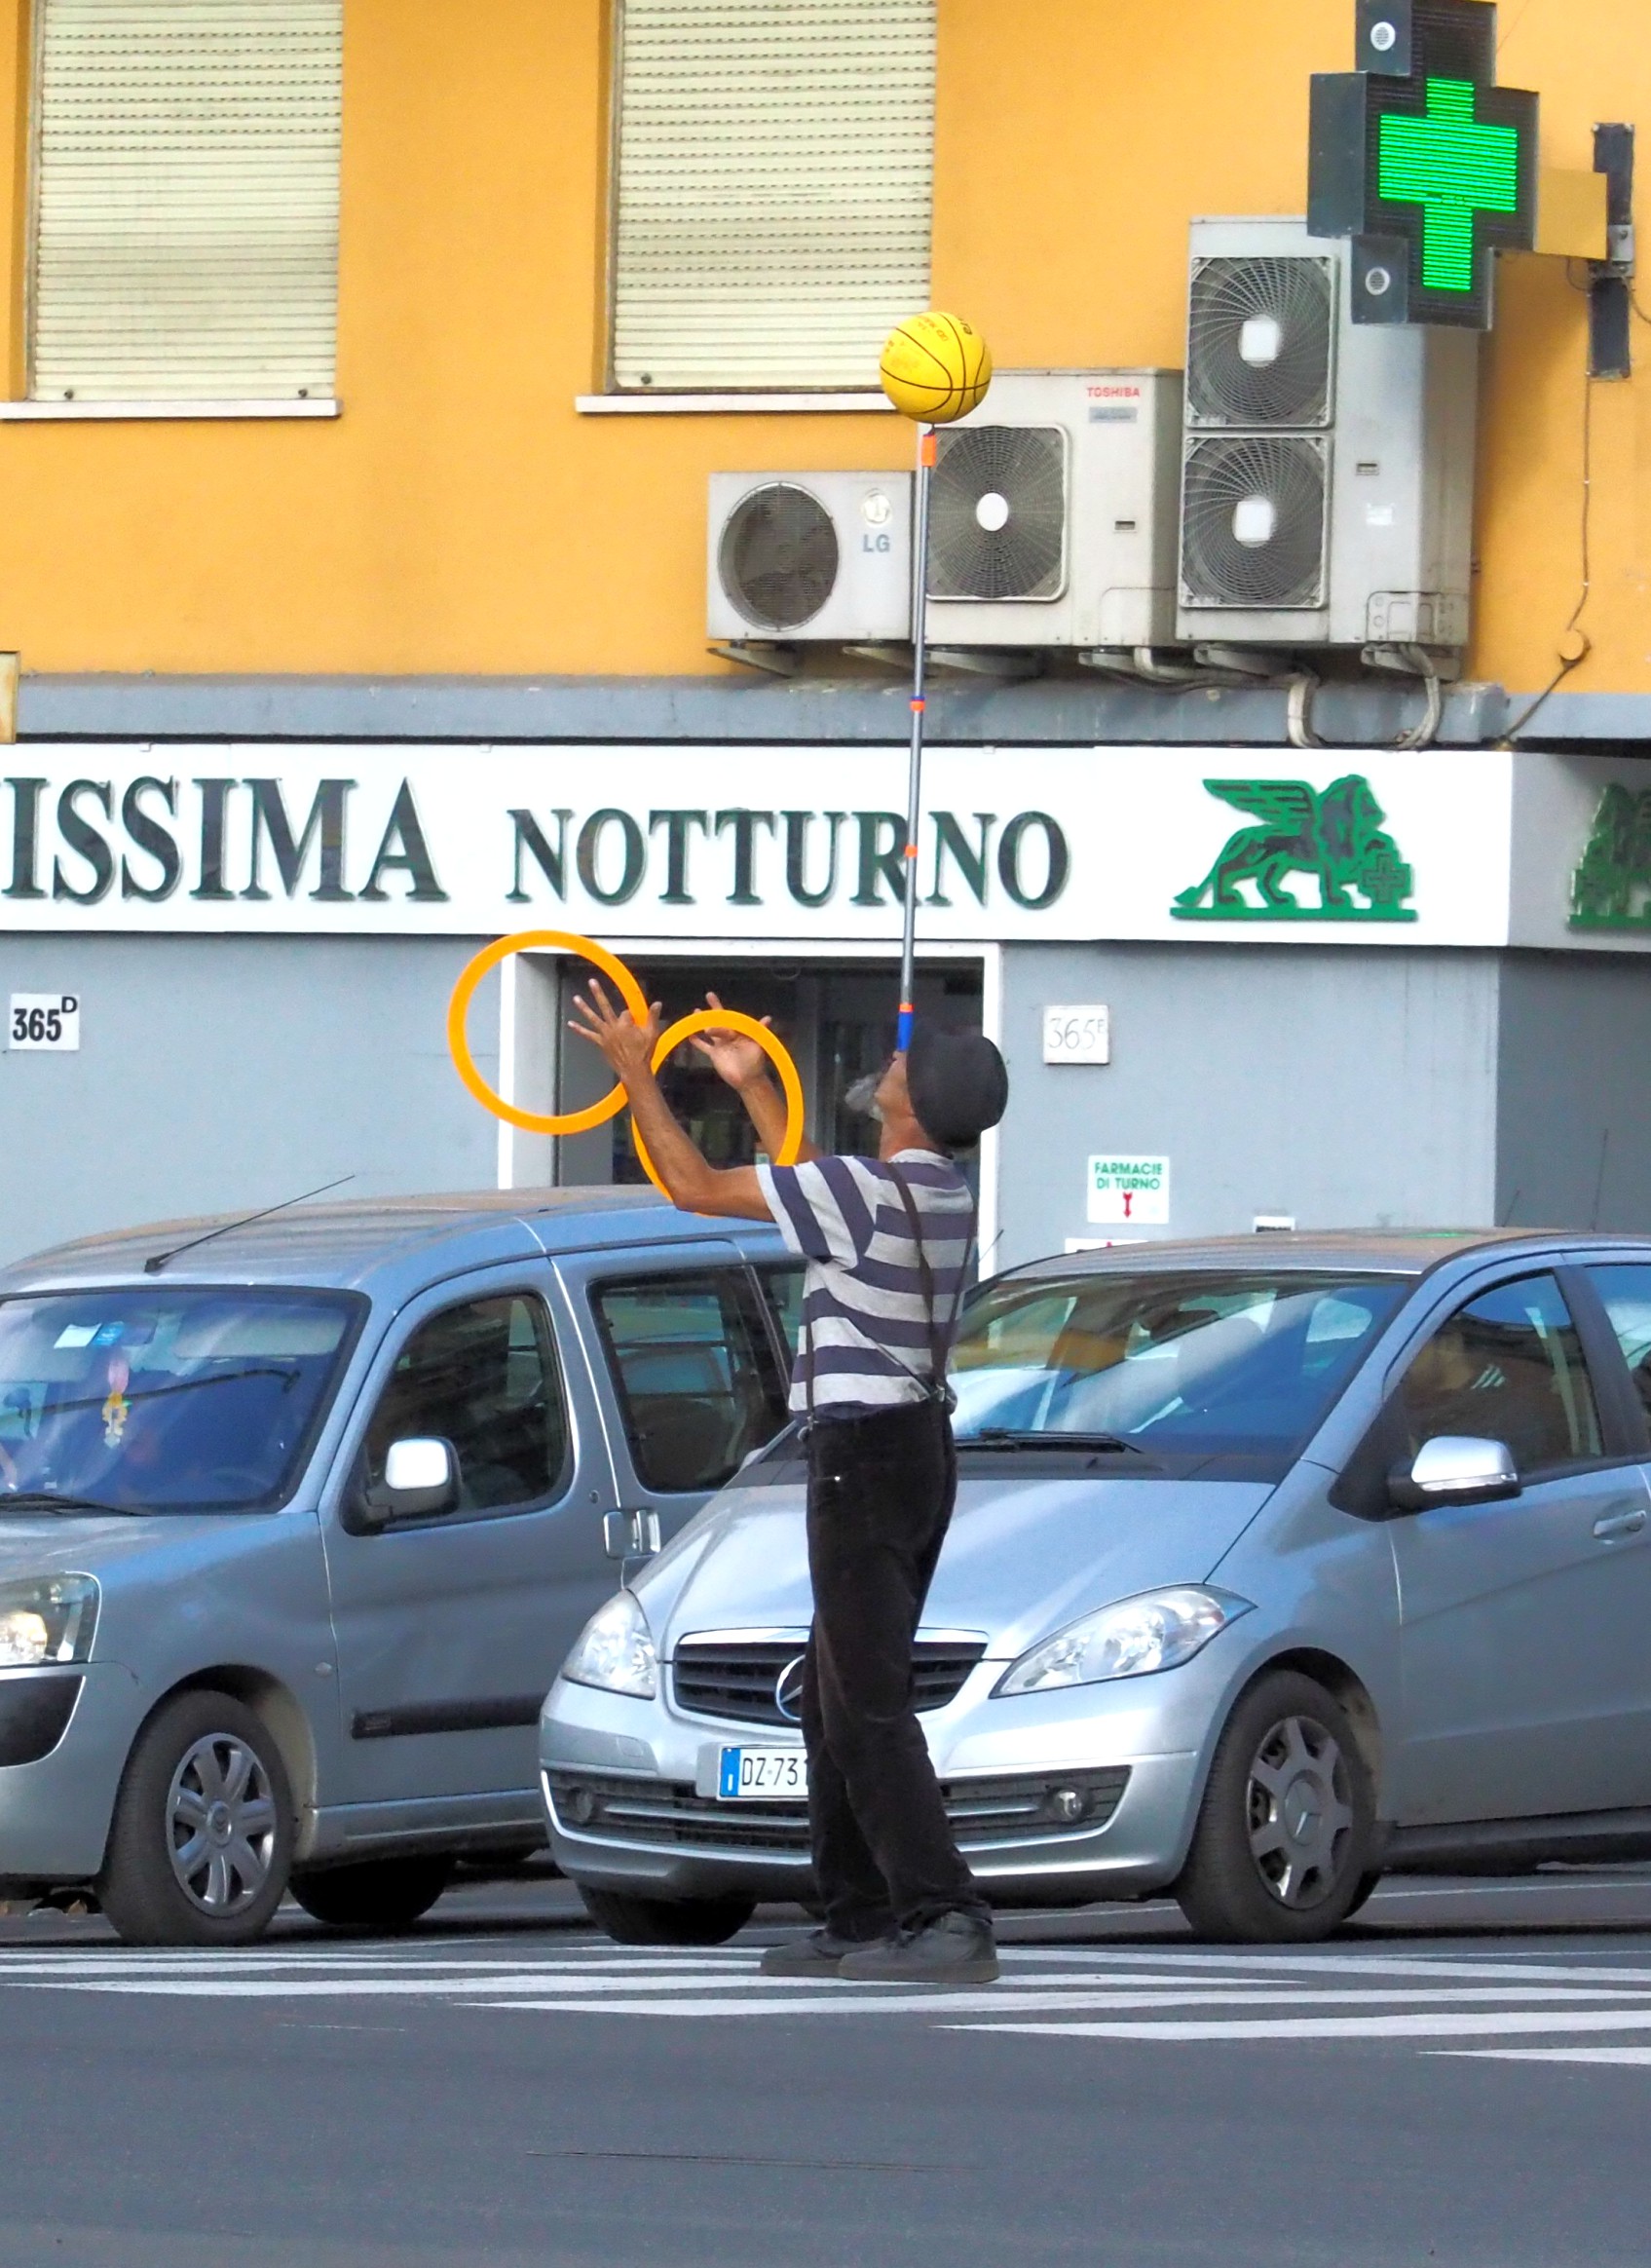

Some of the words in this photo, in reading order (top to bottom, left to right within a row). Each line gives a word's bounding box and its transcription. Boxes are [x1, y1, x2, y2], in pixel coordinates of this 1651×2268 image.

[1086, 386, 1141, 397] TOSHIBA
[862, 533, 891, 553] LG
[2, 775, 451, 905] ISSIMA
[505, 807, 1070, 910] NOTTURNO
[1094, 1161, 1163, 1176] FARMACIE
[1097, 1177, 1110, 1190] DI
[1115, 1177, 1160, 1191] TURNO
